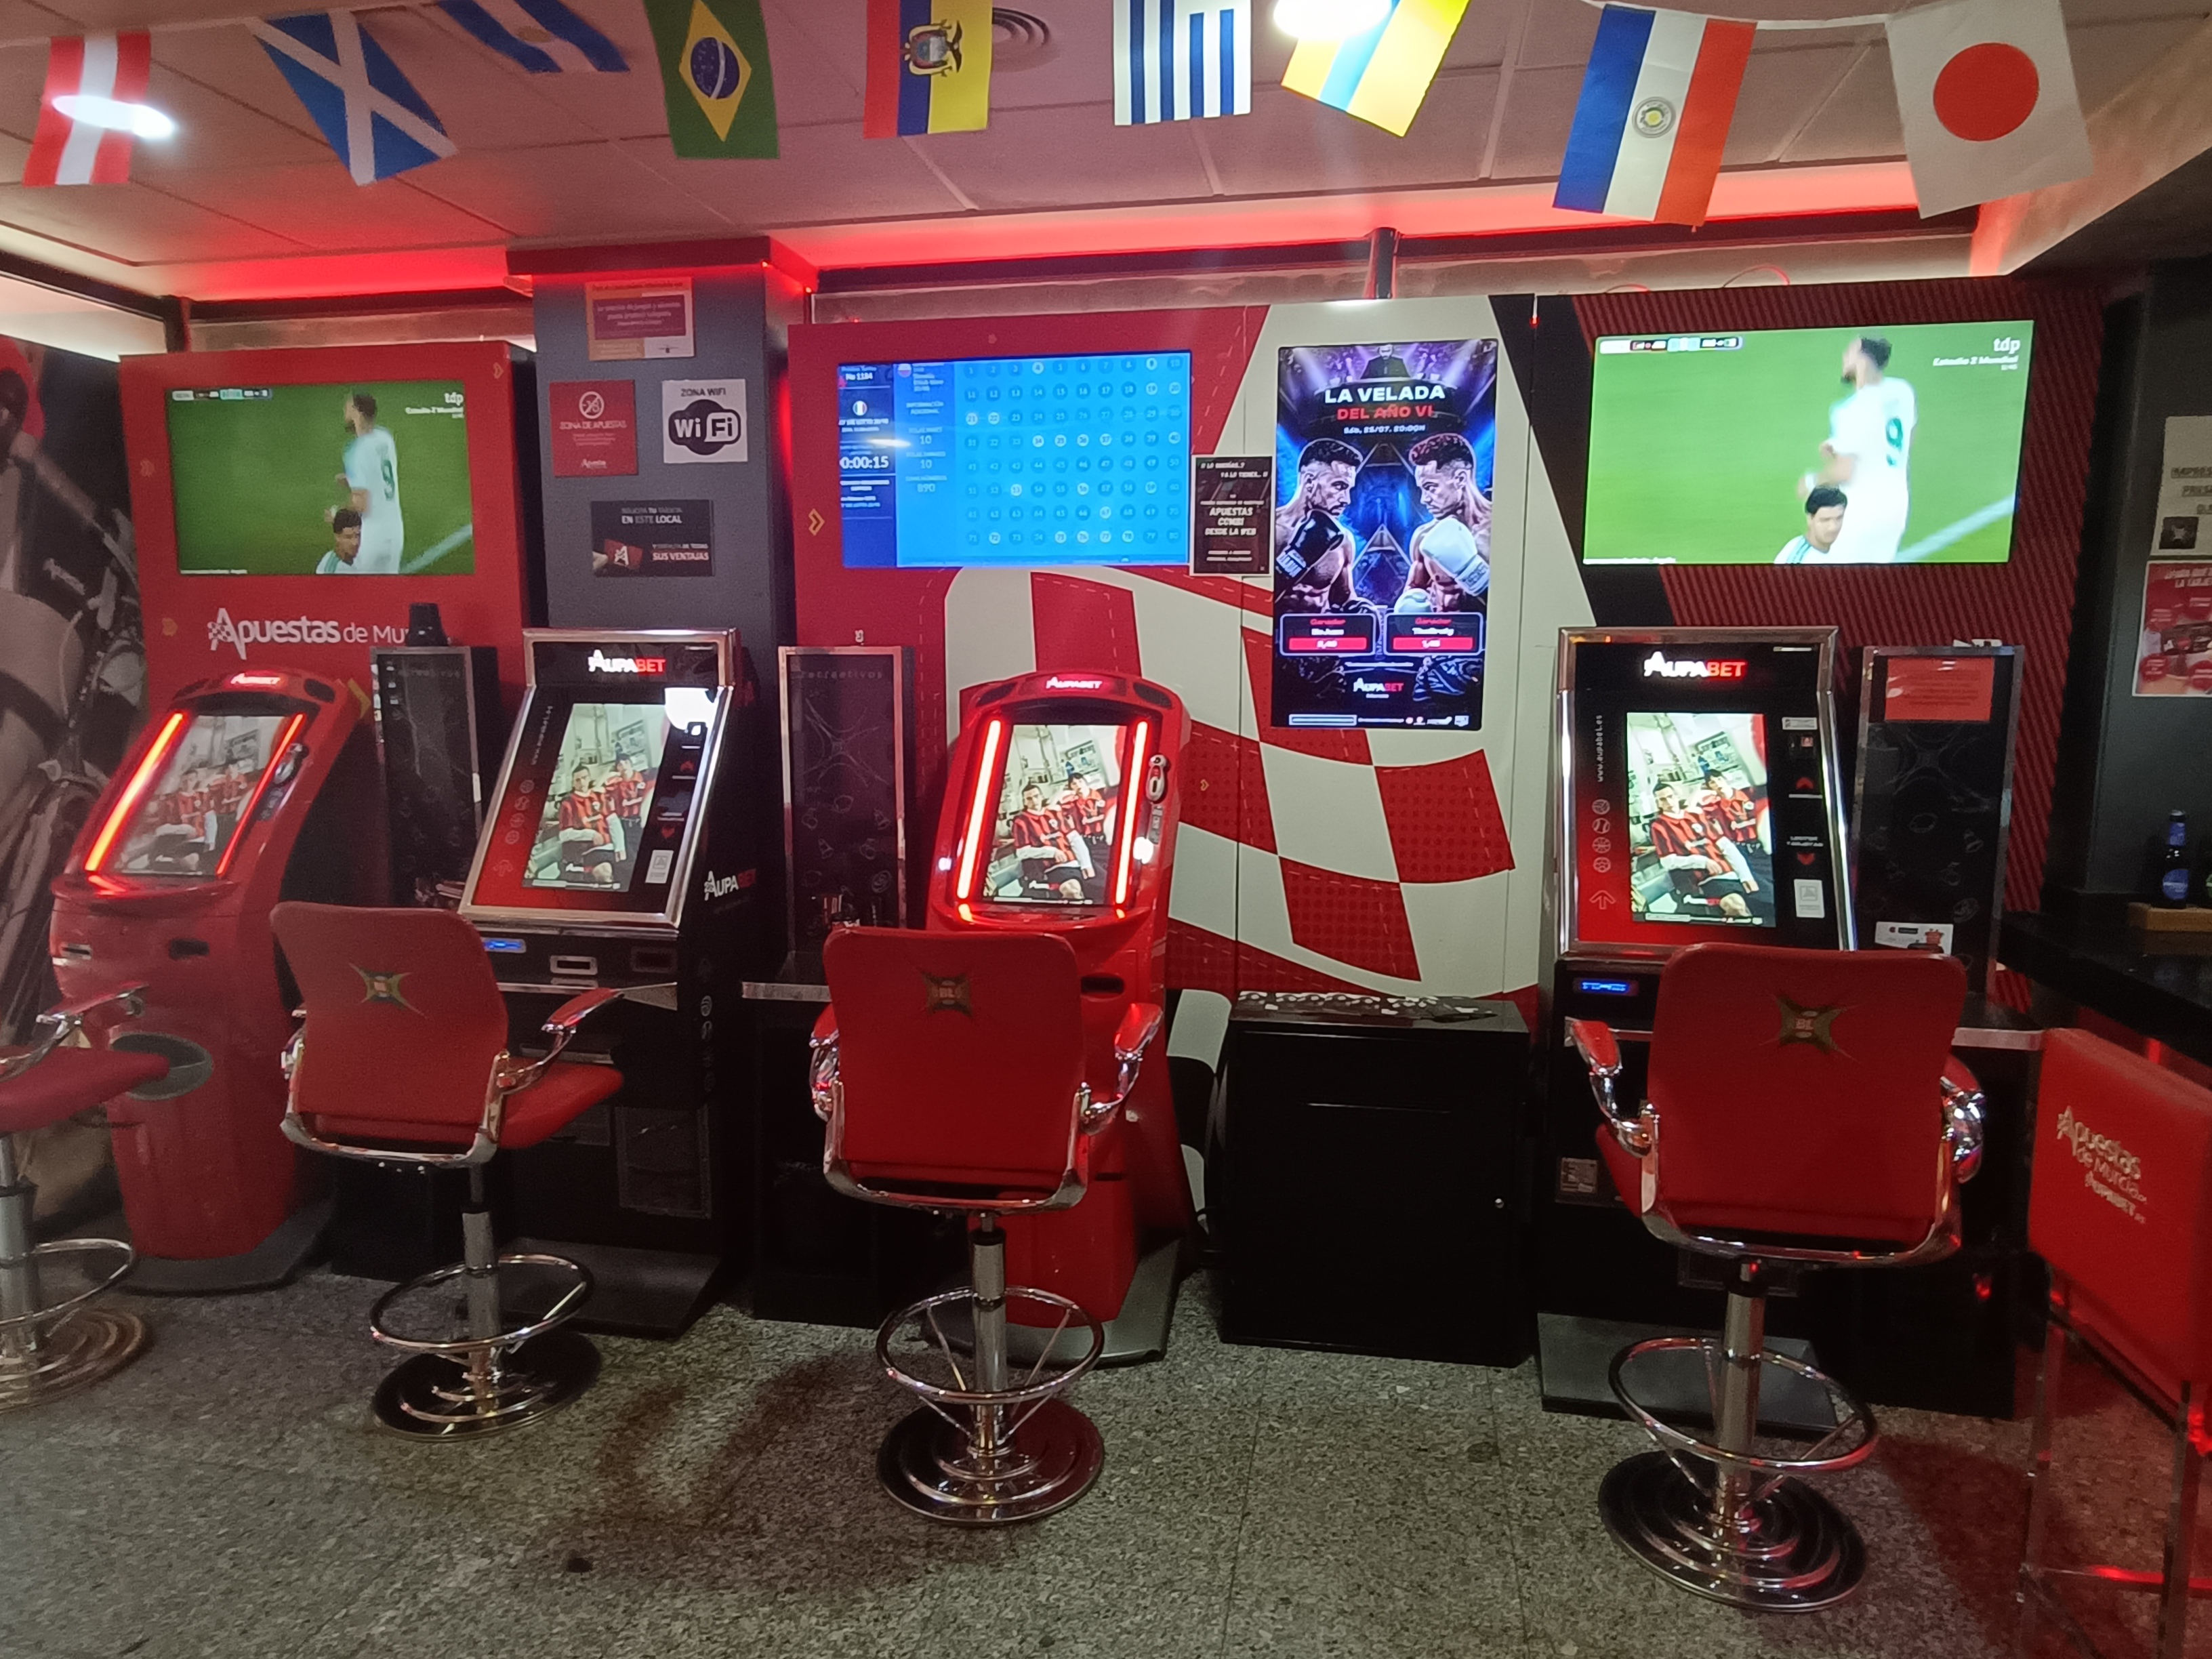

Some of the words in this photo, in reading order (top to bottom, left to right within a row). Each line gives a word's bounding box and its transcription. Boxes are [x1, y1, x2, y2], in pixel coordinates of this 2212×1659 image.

[1993, 337, 2021, 354] tdp
[680, 388, 705, 396] ZONA
[707, 388, 726, 396] WIFI
[1325, 389, 1353, 403] LA
[1357, 385, 1446, 402] VELADA
[1337, 408, 1370, 420] DEL
[1374, 404, 1411, 418] AÑO
[1415, 405, 1433, 417] VI
[920, 435, 932, 445] 10
[920, 459, 933, 469] 10
[655, 515, 682, 524] LOCAL
[1209, 508, 1253, 516] APUESTAS
[207, 608, 341, 660] Apuestas
[343, 621, 369, 643] de
[373, 624, 409, 644] Mu
[588, 649, 666, 672] AUPABET
[1644, 651, 1746, 677] AUPABET
